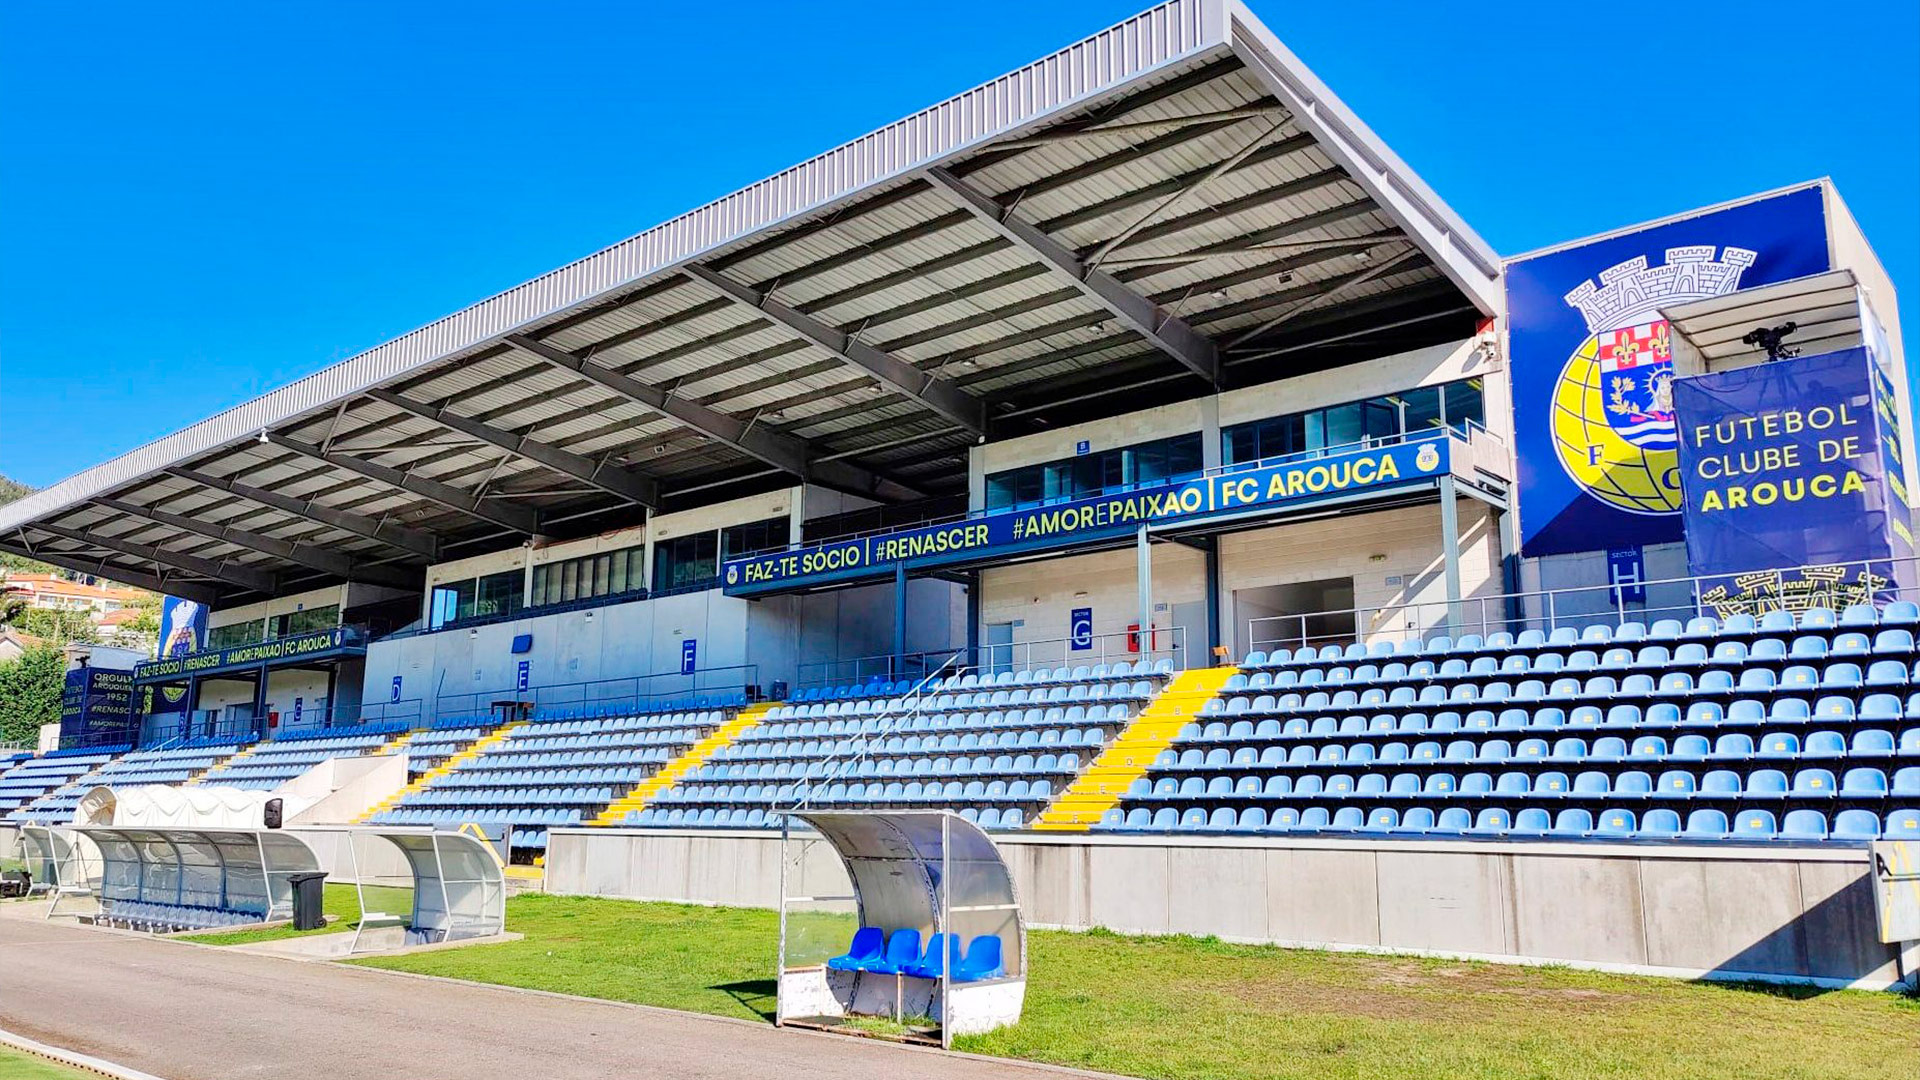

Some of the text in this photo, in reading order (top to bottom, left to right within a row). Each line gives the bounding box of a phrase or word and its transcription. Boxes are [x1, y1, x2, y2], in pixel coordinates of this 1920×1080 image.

[1695, 403, 1857, 448] FUTEBOL
[1587, 444, 1604, 466] F
[1698, 444, 1801, 479] CLUBE
[1818, 436, 1862, 463] DE
[1701, 470, 1866, 512] AROUCA
[745, 454, 1400, 582] FAZ-TE SÓCIO #RENASCER #AMOREPAIXAO FC AROUCA
[1613, 562, 1640, 596] H
[1074, 620, 1090, 646] G
[284, 641, 296, 655] FC
[296, 635, 331, 653] AROUCA
[684, 650, 694, 671] F
[94, 673, 133, 683] ORGULH
[519, 670, 527, 689] E
[106, 693, 128, 702] 1952
[393, 684, 399, 701] D
